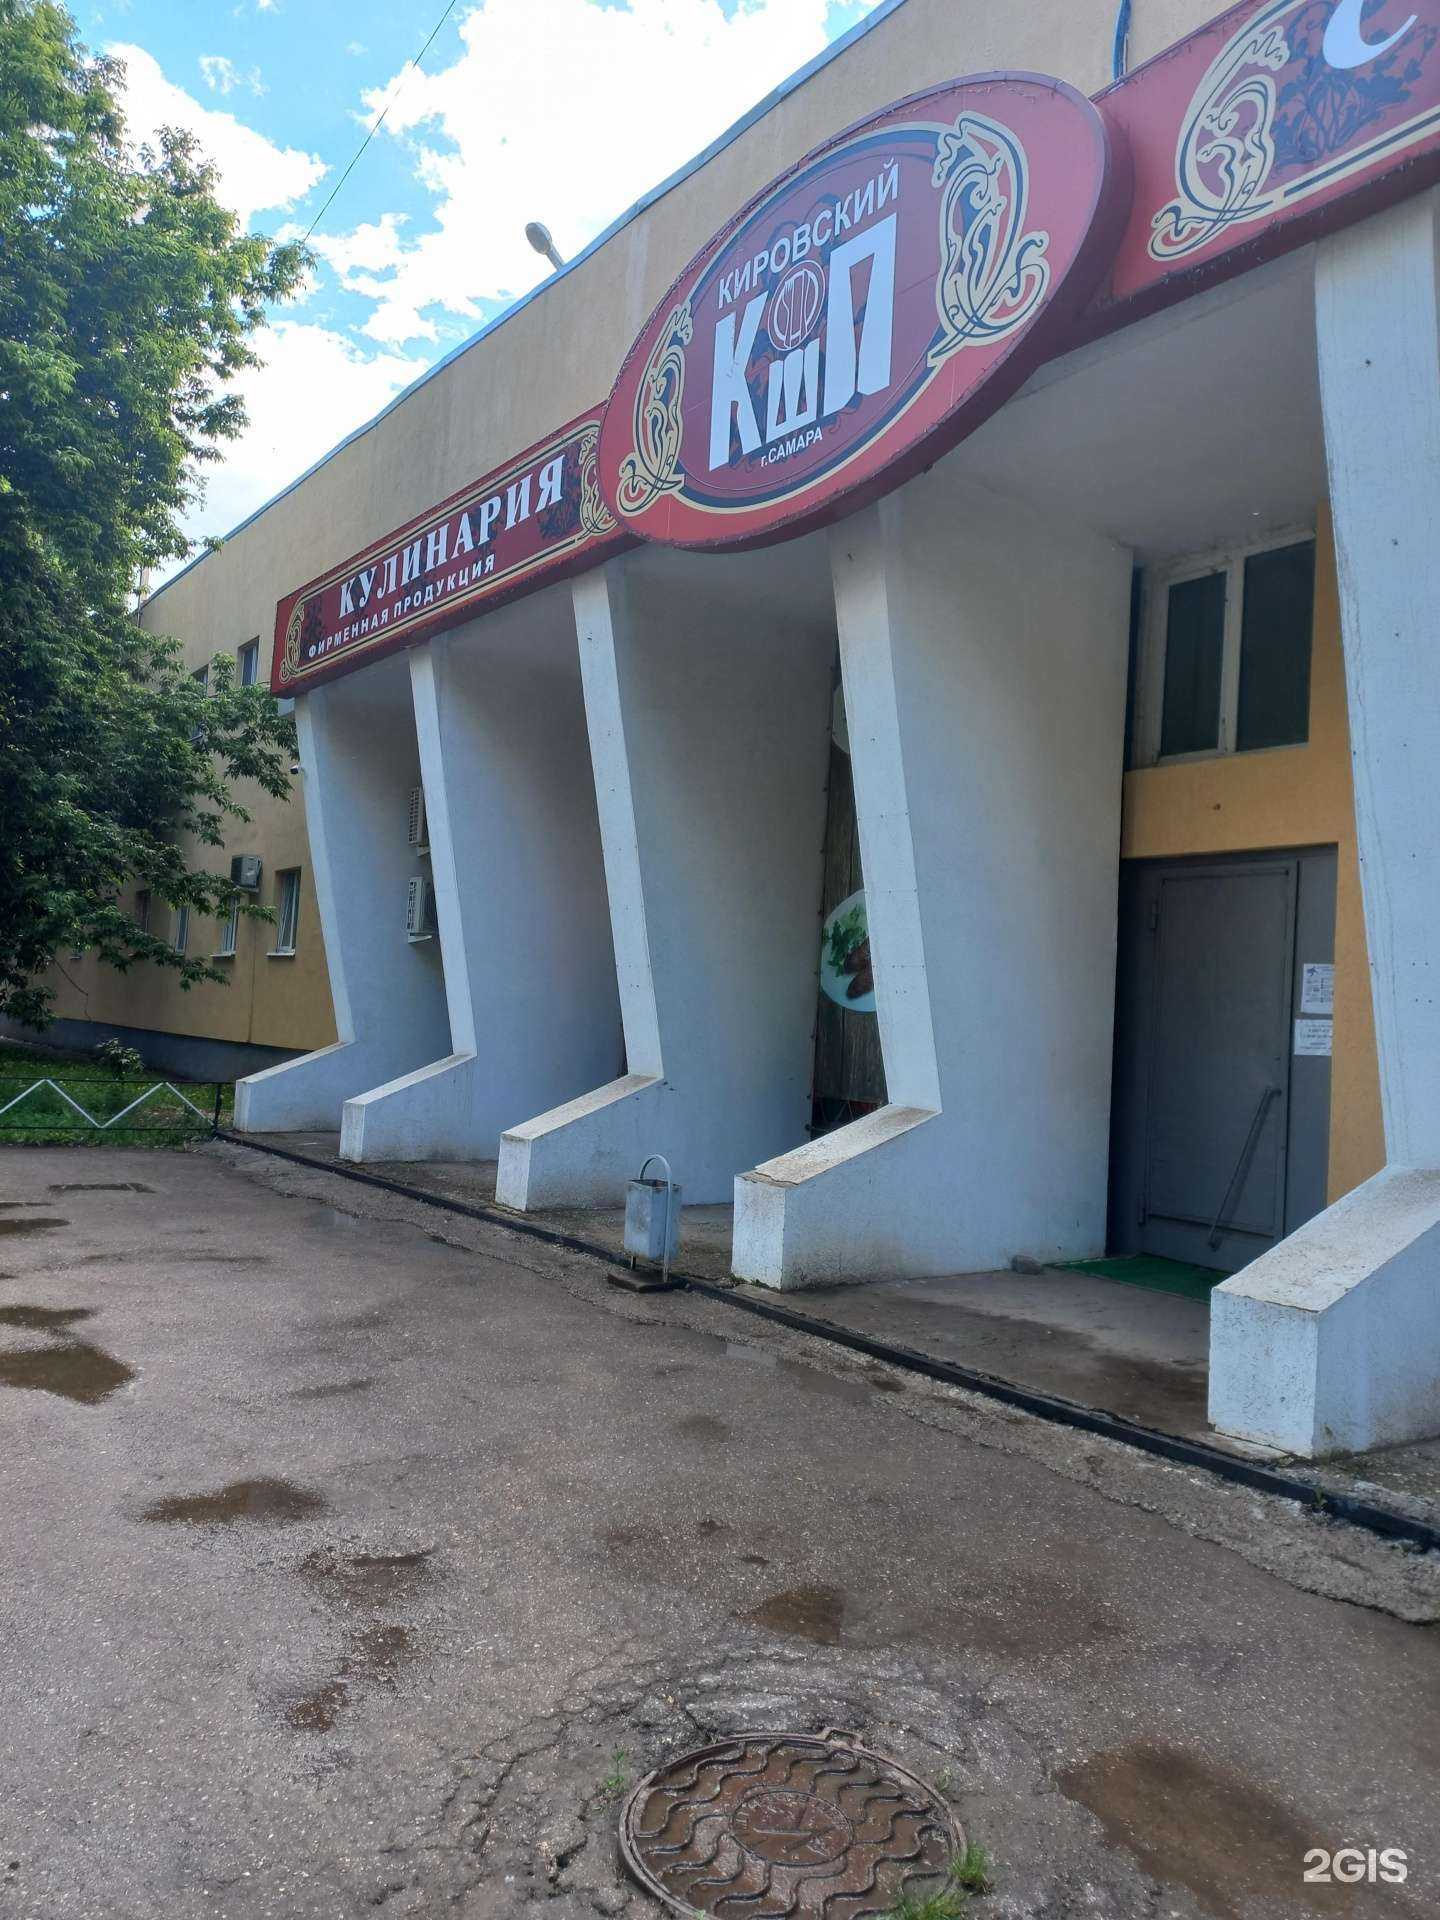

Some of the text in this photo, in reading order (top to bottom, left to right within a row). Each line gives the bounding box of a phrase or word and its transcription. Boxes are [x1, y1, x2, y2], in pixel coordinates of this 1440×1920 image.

[718, 158, 899, 309] КИРОВСКИЙ
[308, 554, 495, 658] ФИРМЕННАЯ ПРОДУКЦИЯ
[337, 455, 565, 619] КУЛИНАРИЯ
